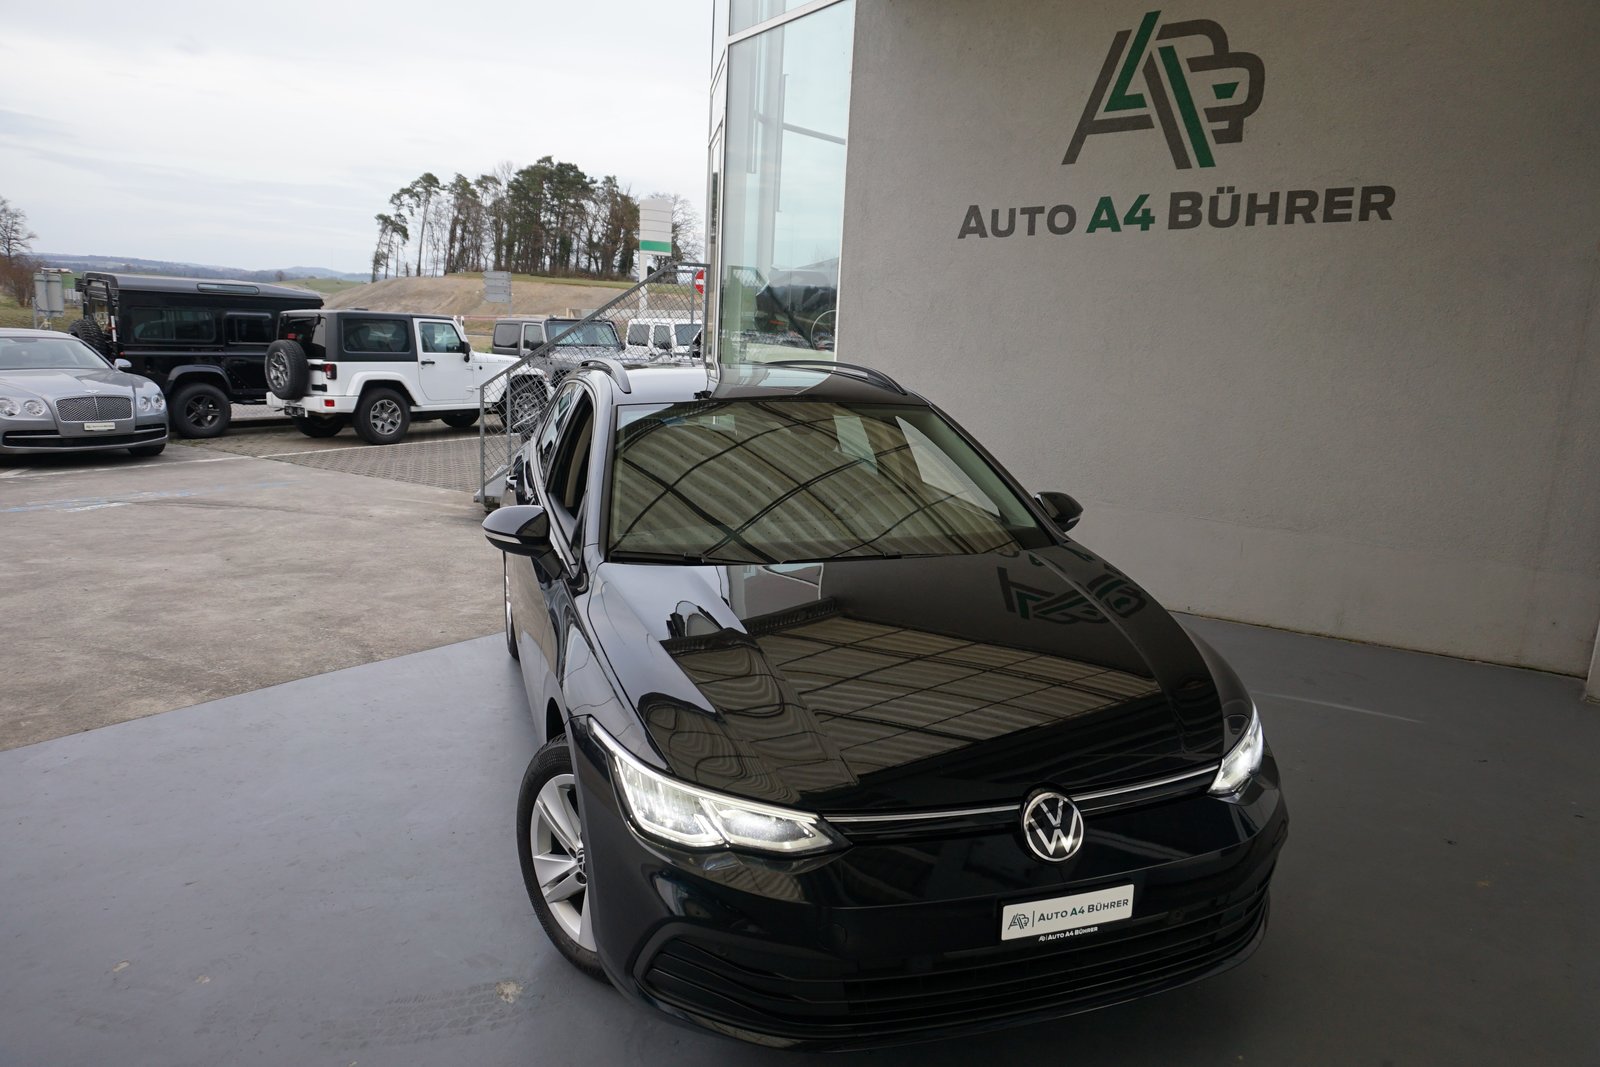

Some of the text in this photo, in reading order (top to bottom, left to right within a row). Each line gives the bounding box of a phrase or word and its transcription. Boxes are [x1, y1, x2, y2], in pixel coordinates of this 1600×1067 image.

[957, 185, 1396, 239] AUTO A4 BÜHRER
[1037, 910, 1068, 923] AUTO
[1069, 907, 1085, 917] A4
[1087, 898, 1129, 914] BÜHRER
[1047, 933, 1065, 941] AUTO
[1074, 926, 1098, 936] BÜHRER
